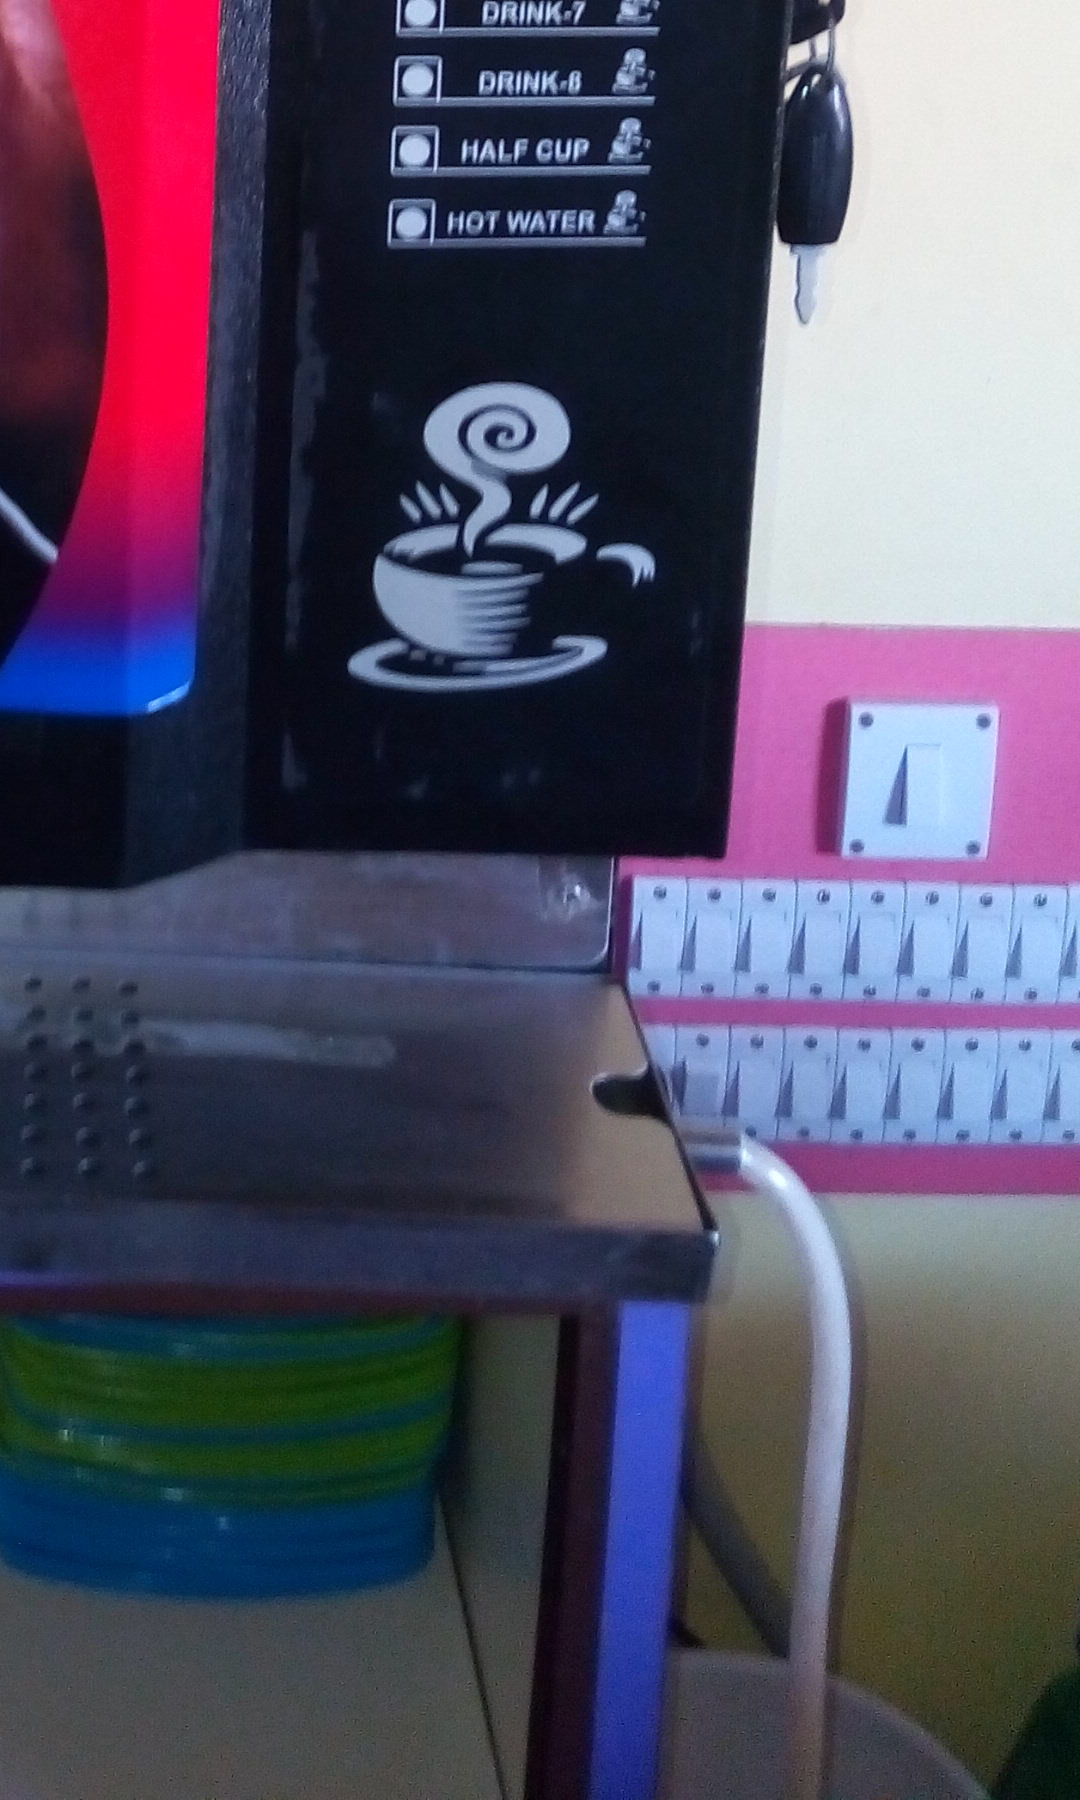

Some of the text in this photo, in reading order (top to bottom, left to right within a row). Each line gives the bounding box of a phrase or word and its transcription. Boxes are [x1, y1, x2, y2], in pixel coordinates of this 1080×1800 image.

[481, 0, 587, 26] DRINK-7
[478, 70, 582, 95] DRINK-8
[460, 138, 590, 163] HALF CUP
[447, 210, 596, 234] HOT WATER
